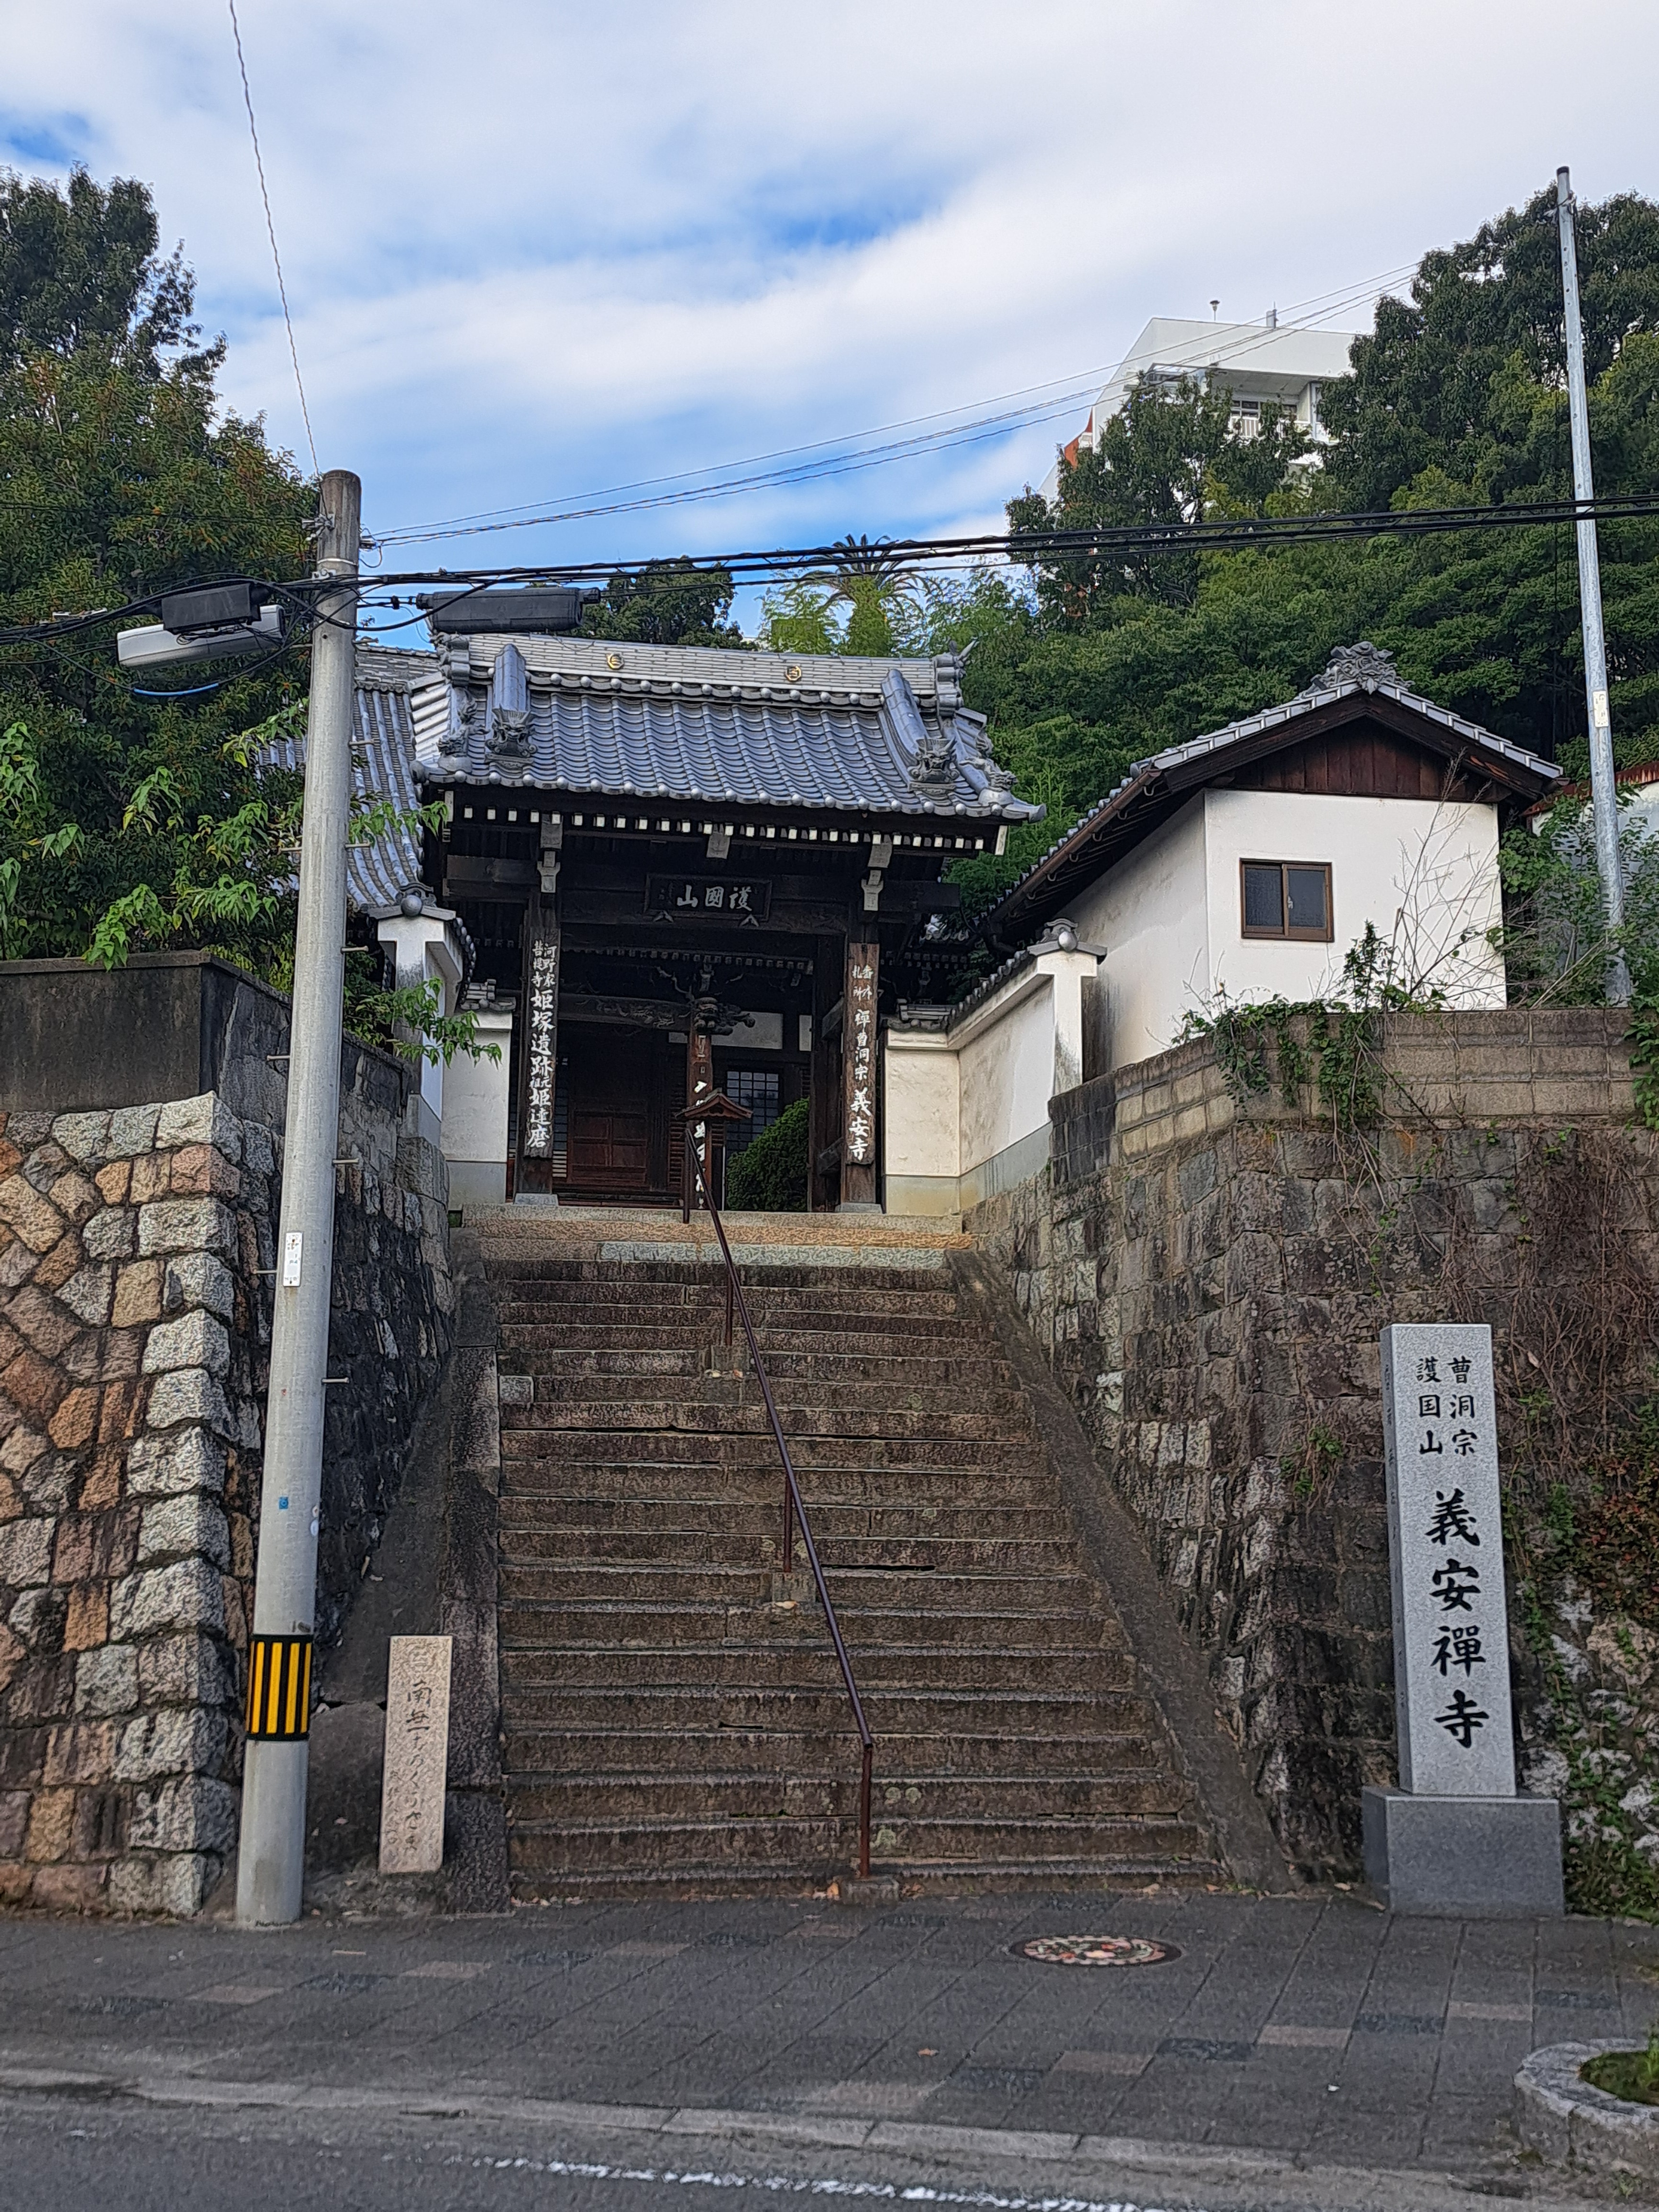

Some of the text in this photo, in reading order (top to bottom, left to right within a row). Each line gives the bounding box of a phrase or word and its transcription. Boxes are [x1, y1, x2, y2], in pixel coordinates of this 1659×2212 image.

[531, 940, 545, 988] 菩提寺
[543, 943, 557, 987] 河野家
[849, 1087, 872, 1161] 義安寺
[1415, 1356, 1443, 1455] 護国山
[1447, 1355, 1478, 1457] 曹洞宗
